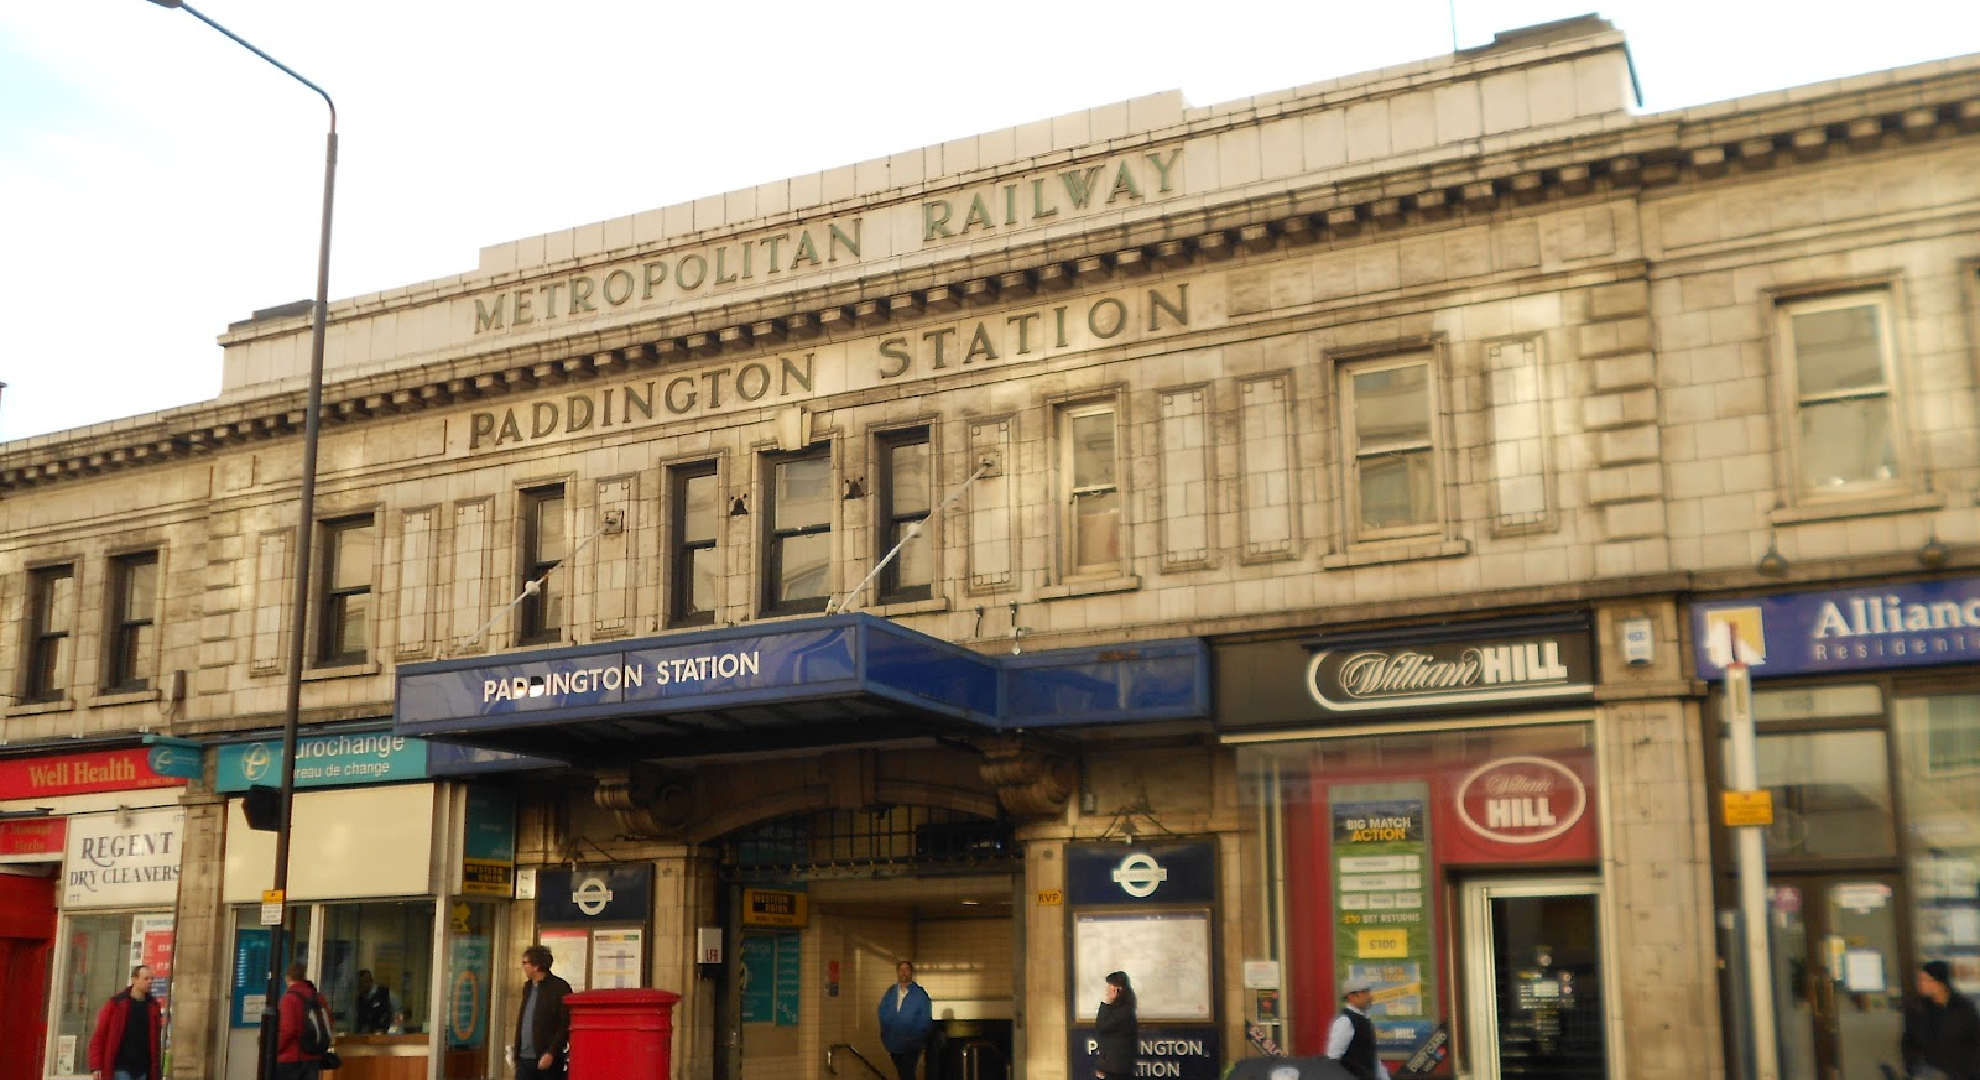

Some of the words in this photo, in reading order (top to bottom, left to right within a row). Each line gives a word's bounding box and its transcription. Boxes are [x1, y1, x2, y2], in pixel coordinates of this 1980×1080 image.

[474, 217, 862, 334] METROPOLITAN
[922, 147, 1184, 242] RAILWAY
[470, 353, 815, 450] PADDINGTON
[879, 283, 1188, 379] STATION
[484, 664, 643, 702] PADDINGTON
[657, 651, 760, 685] STATION
[1339, 649, 1483, 696] William
[1483, 642, 1568, 684] HILL
[281, 736, 404, 758] urochange
[28, 763, 68, 787] Well
[74, 757, 136, 785] Health
[327, 764, 341, 776] de
[345, 762, 390, 777] change
[1487, 774, 1553, 795] William
[1346, 819, 1366, 830] BIG
[1370, 817, 1411, 828] MATCH
[1488, 798, 1557, 827] HILL
[1353, 828, 1406, 841] ACTION
[81, 832, 173, 867] REGENT
[69, 871, 98, 892] DRY
[103, 866, 180, 884] CLEANERS
[1038, 893, 1059, 904] RVP
[1381, 913, 1420, 922] RETURNS
[1087, 1040, 1203, 1056] PNGTON
[1135, 1061, 1180, 1077] TION
